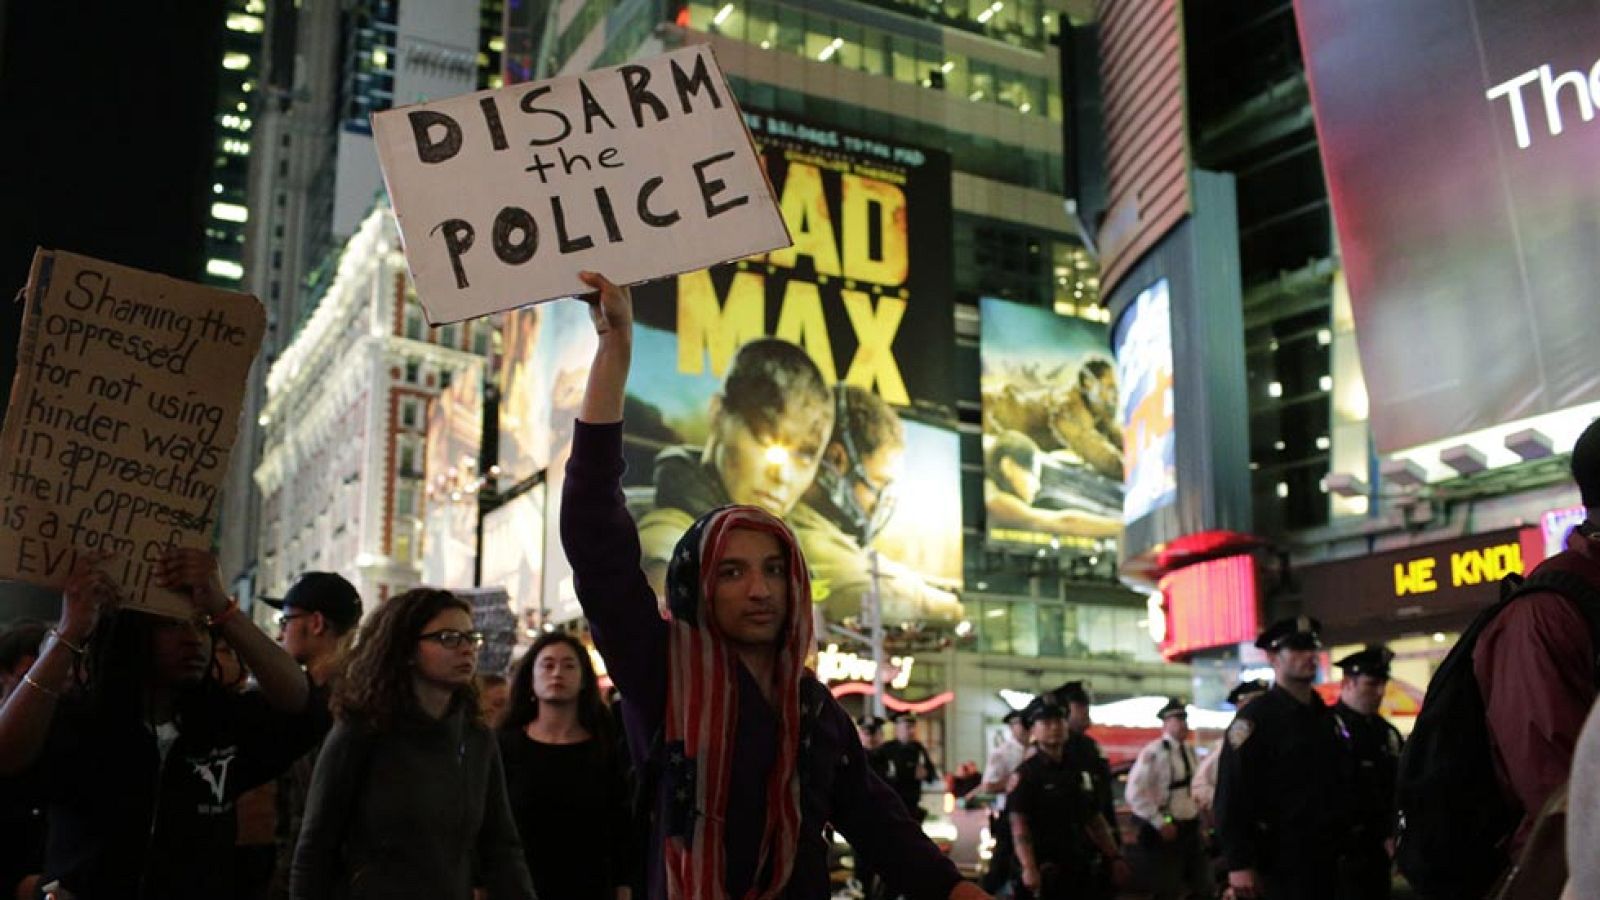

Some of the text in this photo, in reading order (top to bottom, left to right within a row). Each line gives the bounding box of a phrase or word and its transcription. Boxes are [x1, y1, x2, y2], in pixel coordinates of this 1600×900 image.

[408, 54, 723, 163] DISARM
[1486, 59, 1600, 149] Th
[525, 147, 625, 183] the
[430, 151, 749, 289] POLICE
[764, 160, 910, 287] AD
[46, 314, 199, 374] oppressed
[196, 308, 246, 346] the
[677, 266, 911, 406] MAX
[35, 343, 223, 443] for not using
[19, 420, 54, 459] in
[26, 388, 230, 473] kinder ways
[9, 458, 85, 505] their
[3, 497, 29, 531] is
[39, 511, 59, 538] a
[68, 508, 135, 556] form
[1394, 557, 1438, 596] WE
